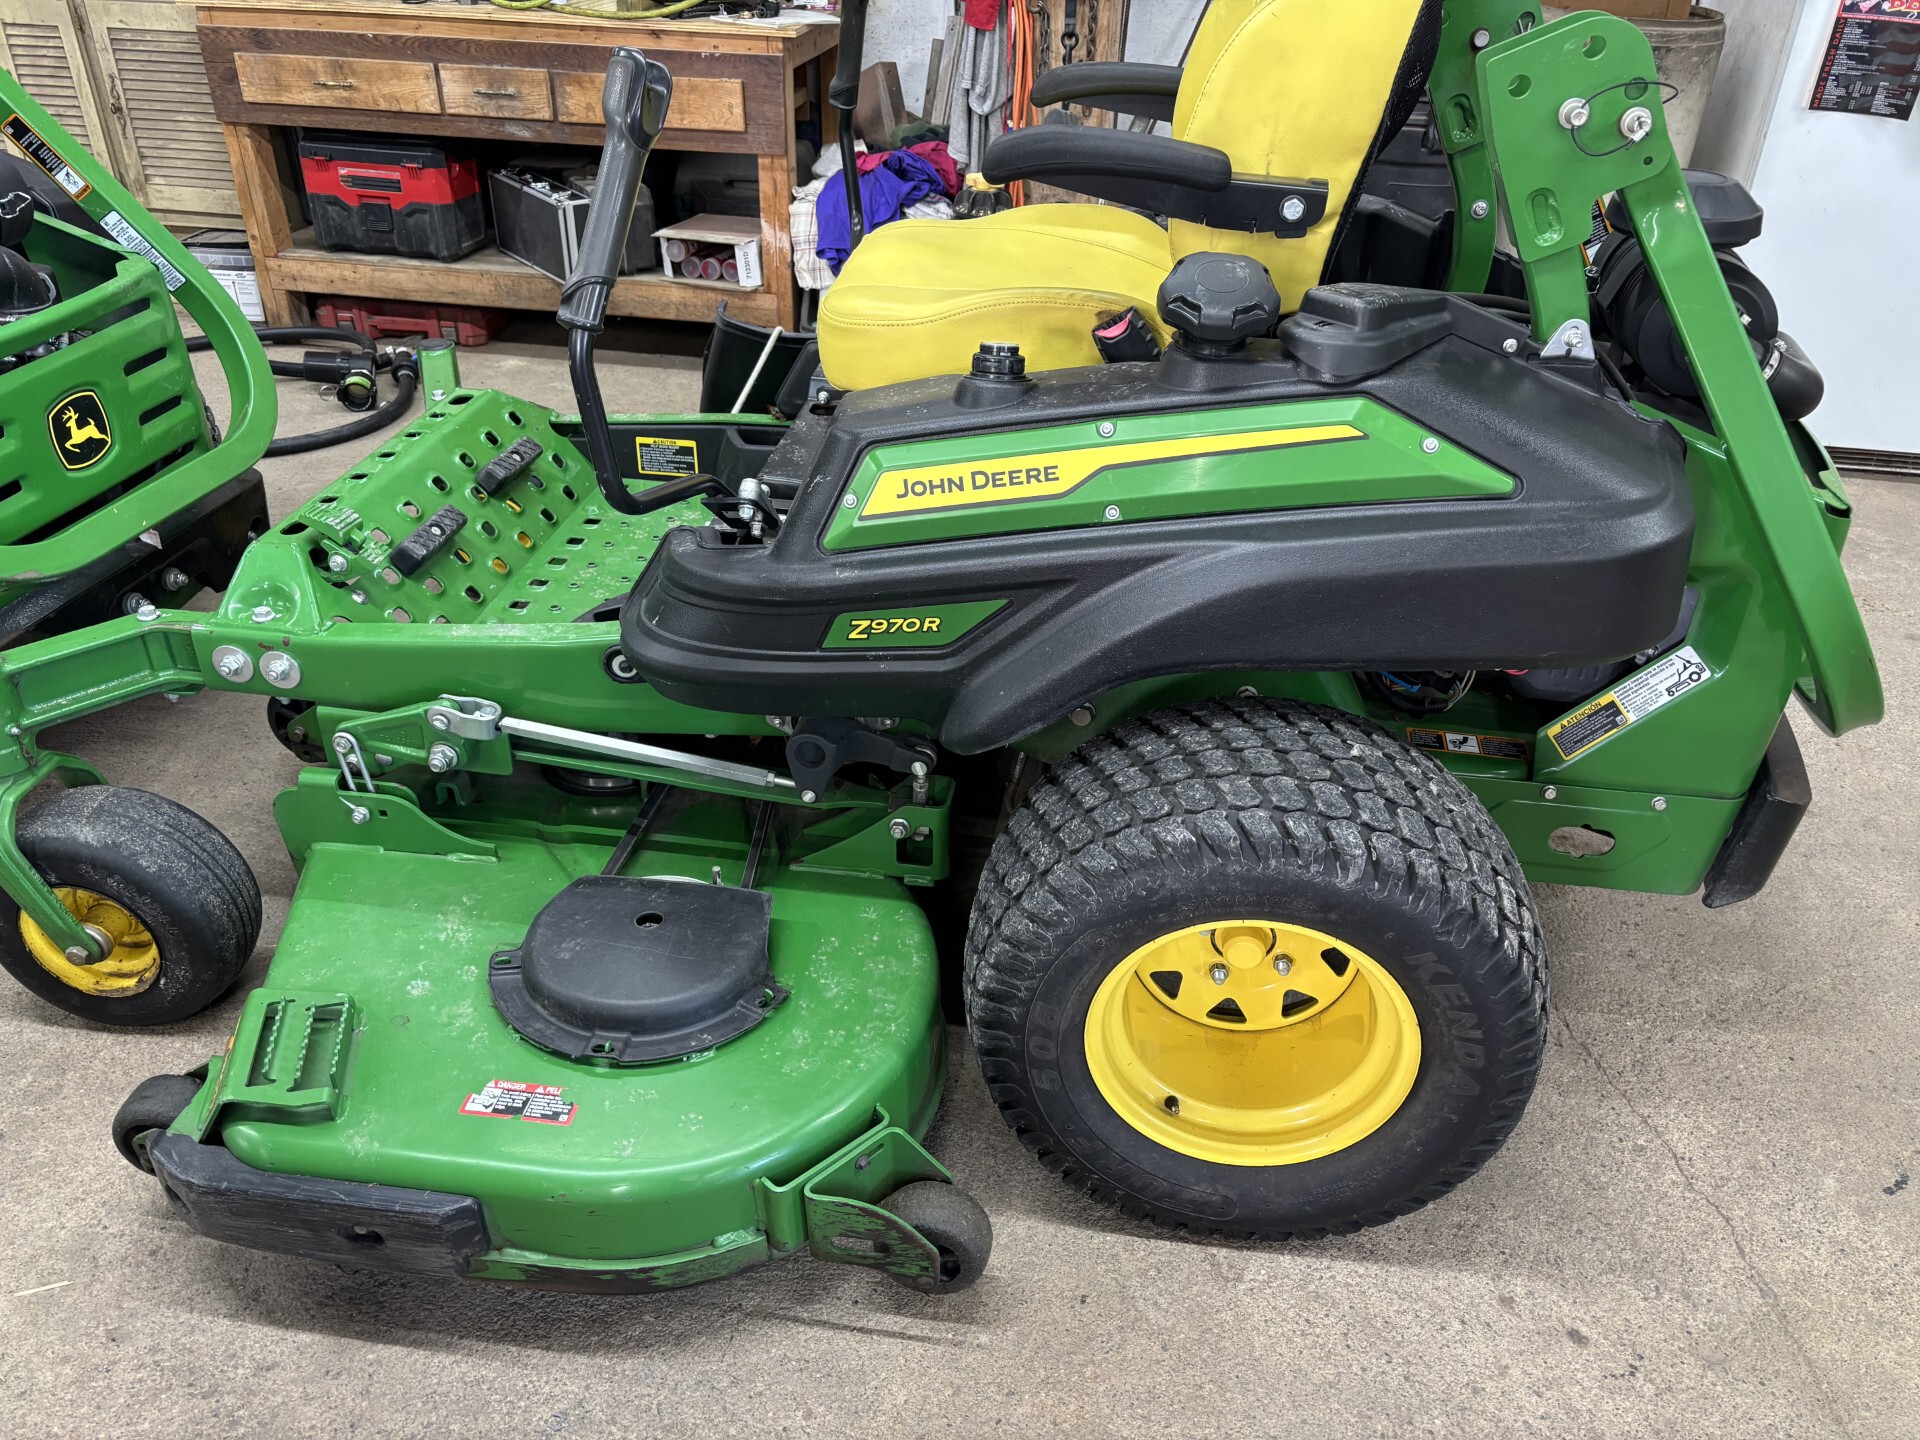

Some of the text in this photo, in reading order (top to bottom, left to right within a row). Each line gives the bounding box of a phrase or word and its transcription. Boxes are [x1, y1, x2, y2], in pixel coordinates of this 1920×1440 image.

[1814, 19, 1845, 107] MADE FRESH DAILY
[896, 465, 1060, 499] JOHN DEERE
[847, 617, 941, 639] Z970R
[1567, 701, 1602, 726] ATENCIÓN
[1404, 952, 1485, 1095] KENDA
[1029, 1001, 1061, 1091] 505
[497, 1081, 526, 1090] DANGER
